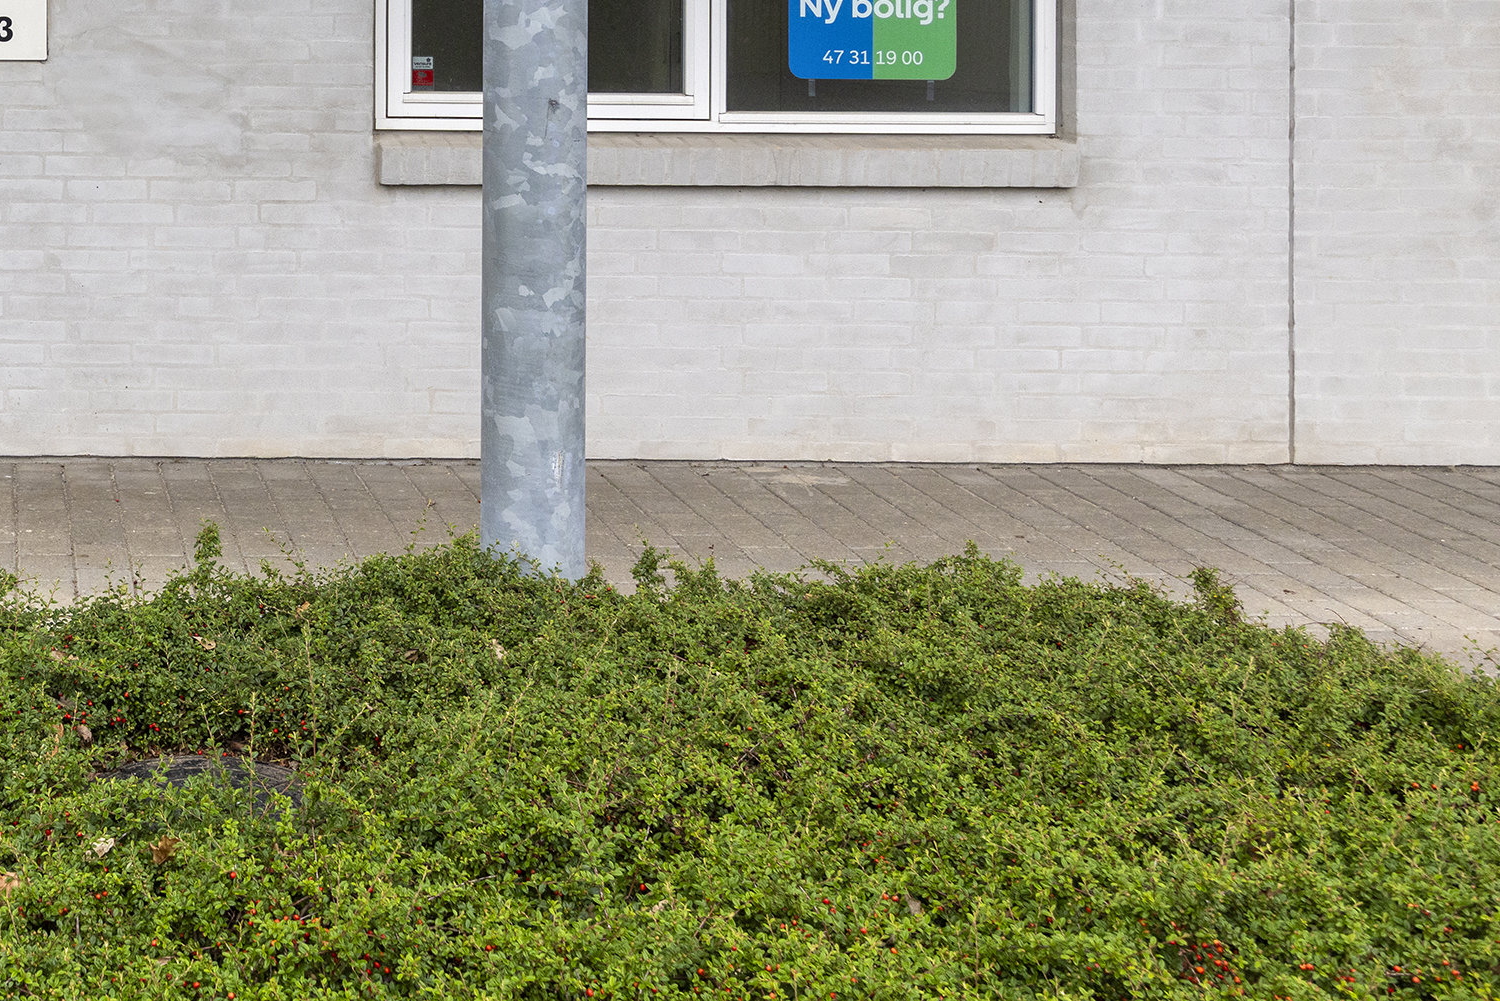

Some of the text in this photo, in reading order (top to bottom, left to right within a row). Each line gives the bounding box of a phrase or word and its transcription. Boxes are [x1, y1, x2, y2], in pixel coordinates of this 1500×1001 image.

[822, 50, 924, 65] 47 31 19 00
